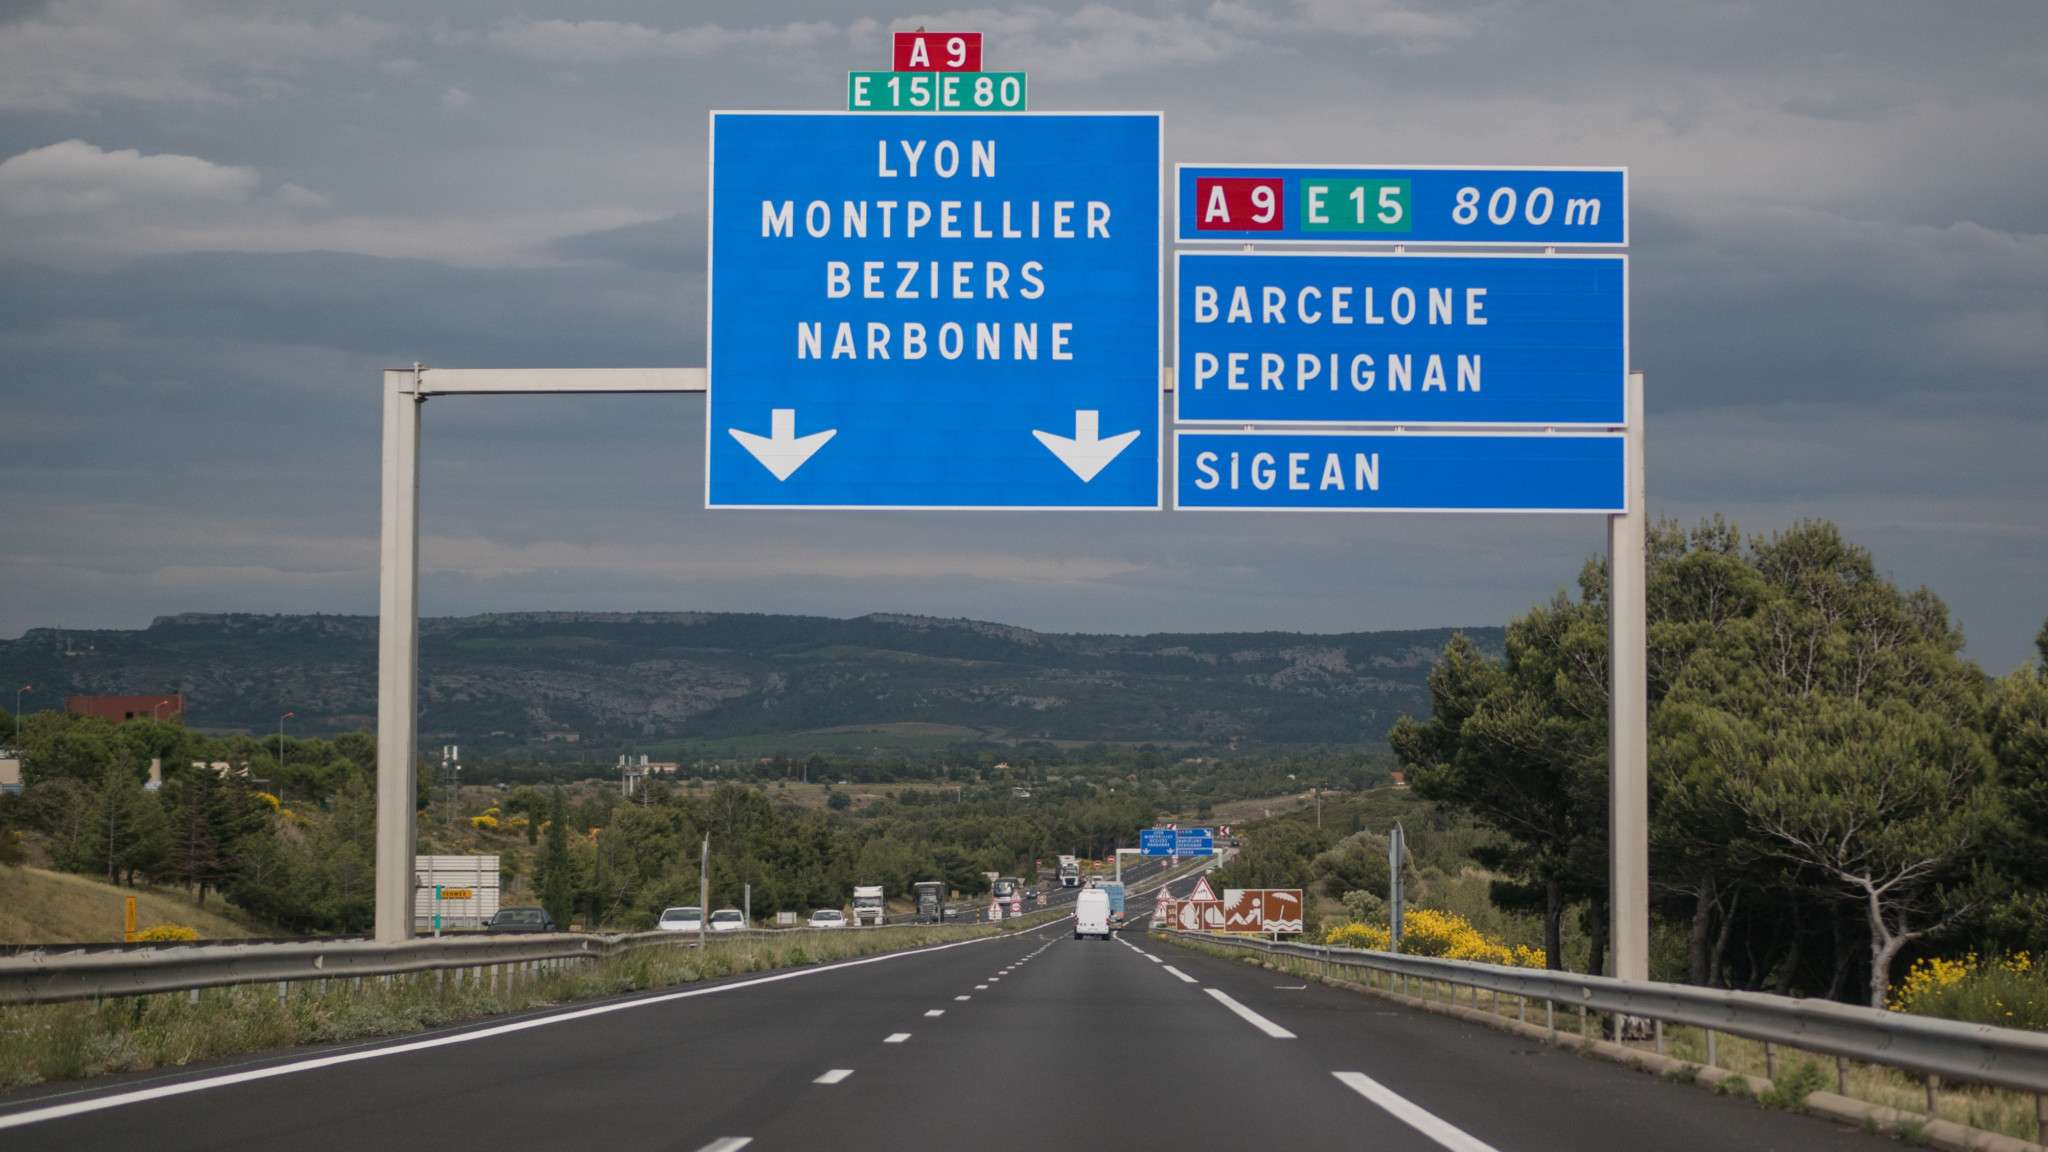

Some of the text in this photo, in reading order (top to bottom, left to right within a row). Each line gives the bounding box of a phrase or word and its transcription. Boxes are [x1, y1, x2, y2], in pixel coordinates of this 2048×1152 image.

[909, 37, 966, 68] A 9
[854, 76, 931, 107] E 15
[943, 76, 1021, 107] E 80
[878, 140, 996, 178] LYON
[761, 199, 1112, 239] MONTPELLIER
[1204, 185, 1276, 224] A 9
[1308, 186, 1404, 225] E 15
[826, 260, 1046, 300] BEZIERS
[1194, 285, 1489, 326] BARCELONE
[797, 321, 1074, 361] NARBONNE
[1194, 352, 1482, 392] PERPIGNAN
[1194, 451, 1380, 491] SIGEAN
